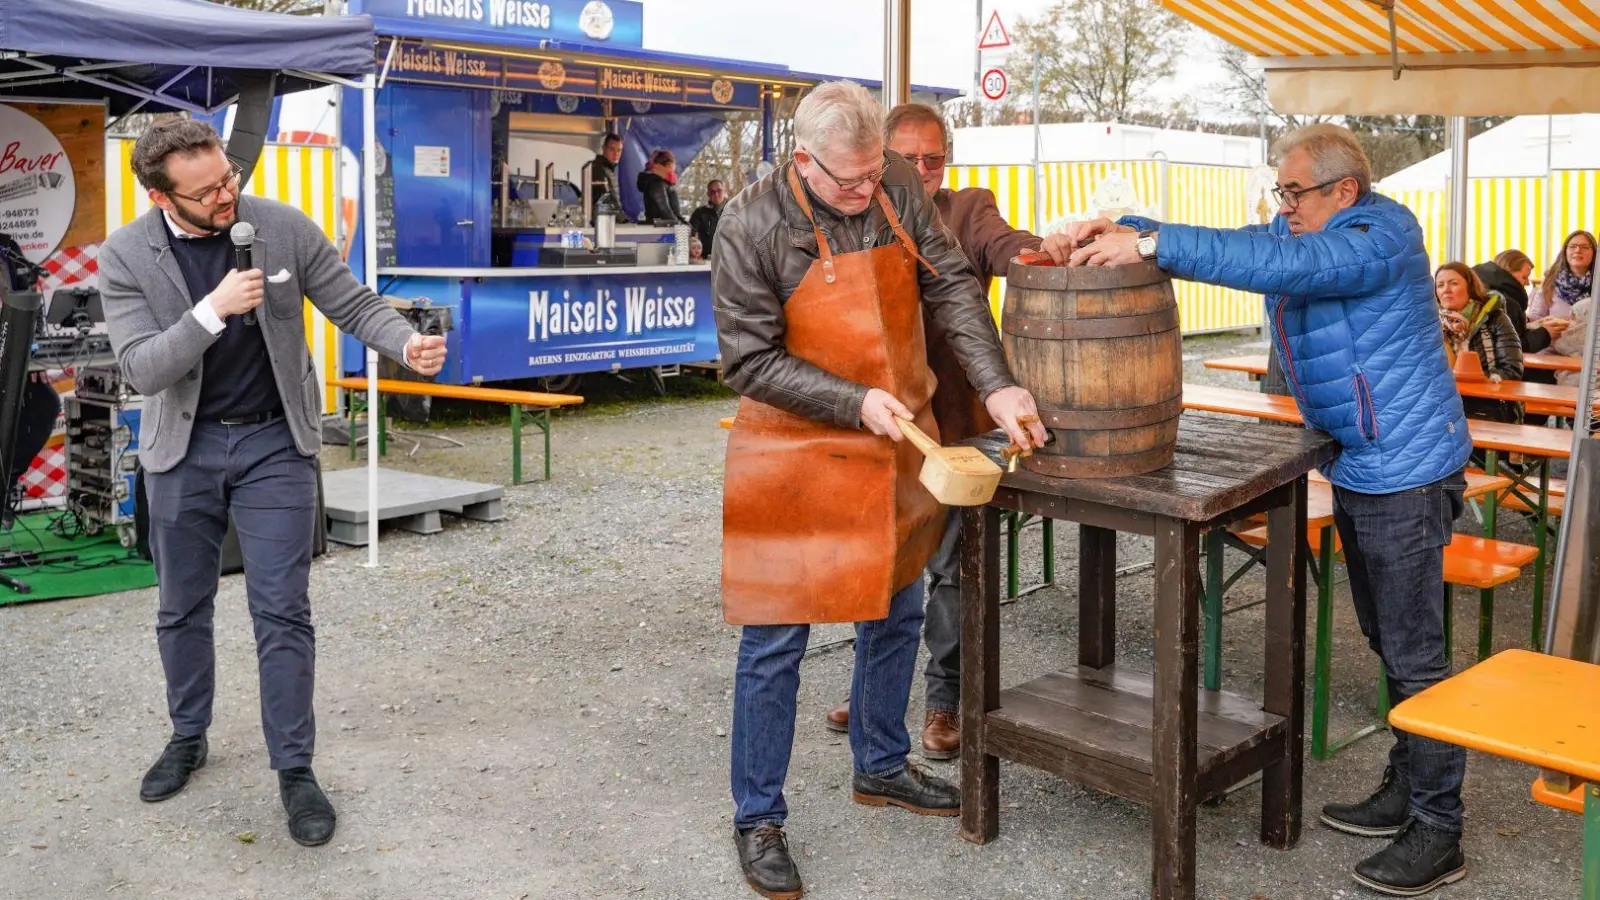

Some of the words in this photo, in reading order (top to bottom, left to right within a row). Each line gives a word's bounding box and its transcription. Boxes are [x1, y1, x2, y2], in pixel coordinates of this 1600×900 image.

[489, 0, 550, 29] Weisse
[391, 47, 441, 73] Maisel's
[444, 51, 486, 77] Weisse
[603, 68, 642, 90] Maisel's
[644, 72, 677, 93] Weisse
[987, 77, 1002, 92] 30
[528, 288, 618, 342] Maisel's
[624, 286, 696, 335] Weisse
[529, 353, 563, 366] BAYERNS
[565, 350, 616, 363] EINZIGARTIGE
[618, 343, 696, 358] WEISSBIERSPEZIALITÄT
